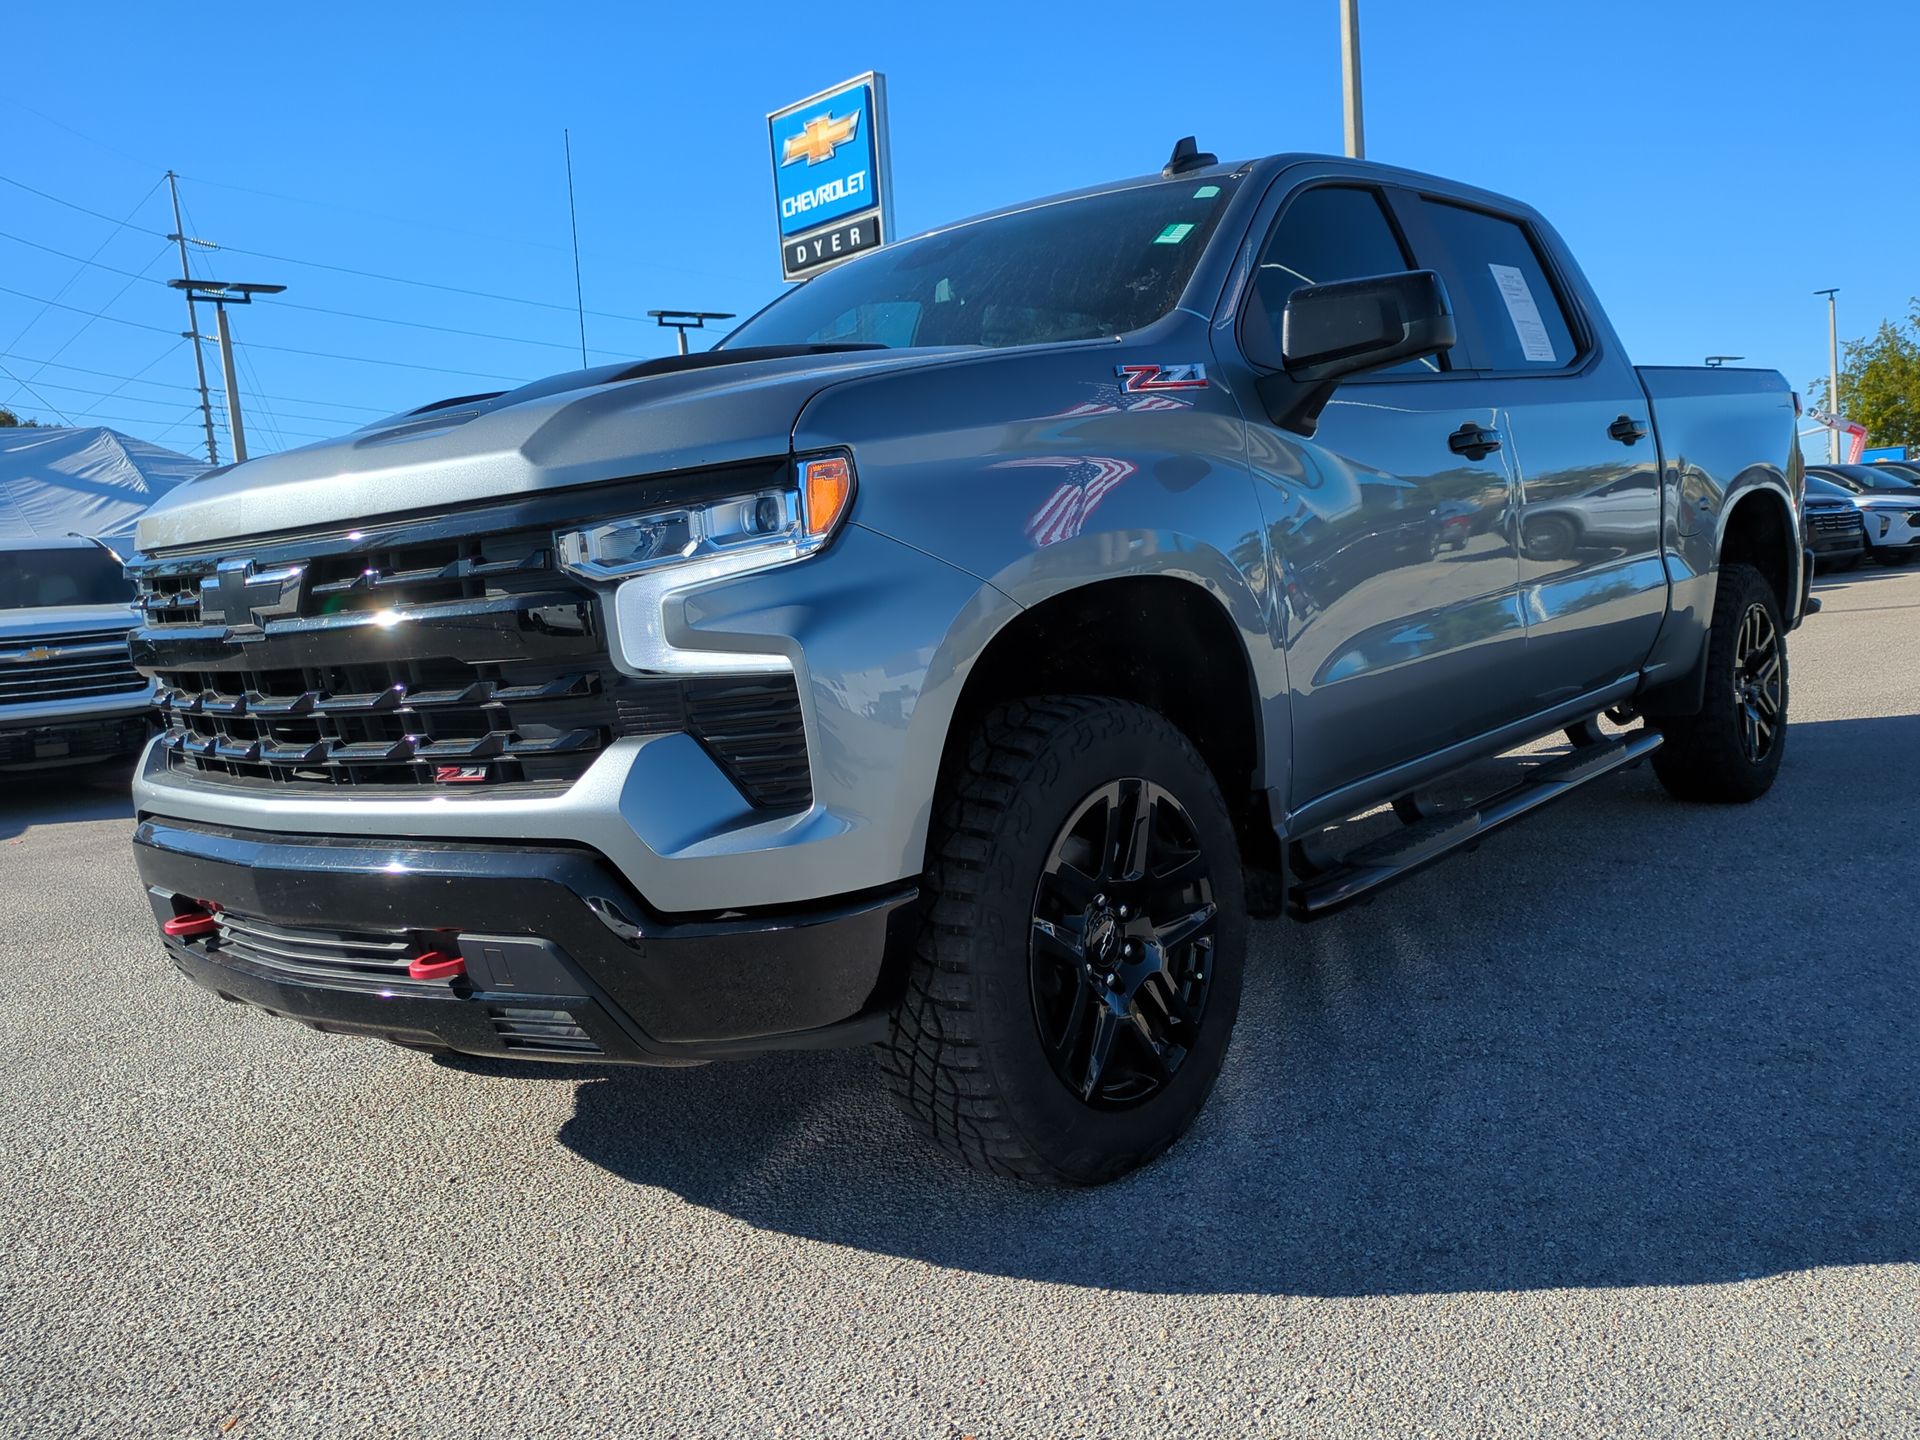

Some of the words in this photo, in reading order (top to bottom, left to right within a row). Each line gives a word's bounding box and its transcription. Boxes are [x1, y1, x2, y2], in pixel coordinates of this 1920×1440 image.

[782, 170, 866, 218] CHEVROLET
[796, 227, 861, 263] DYER
[1114, 363, 1209, 394] Z71
[436, 767, 487, 783] Z71
